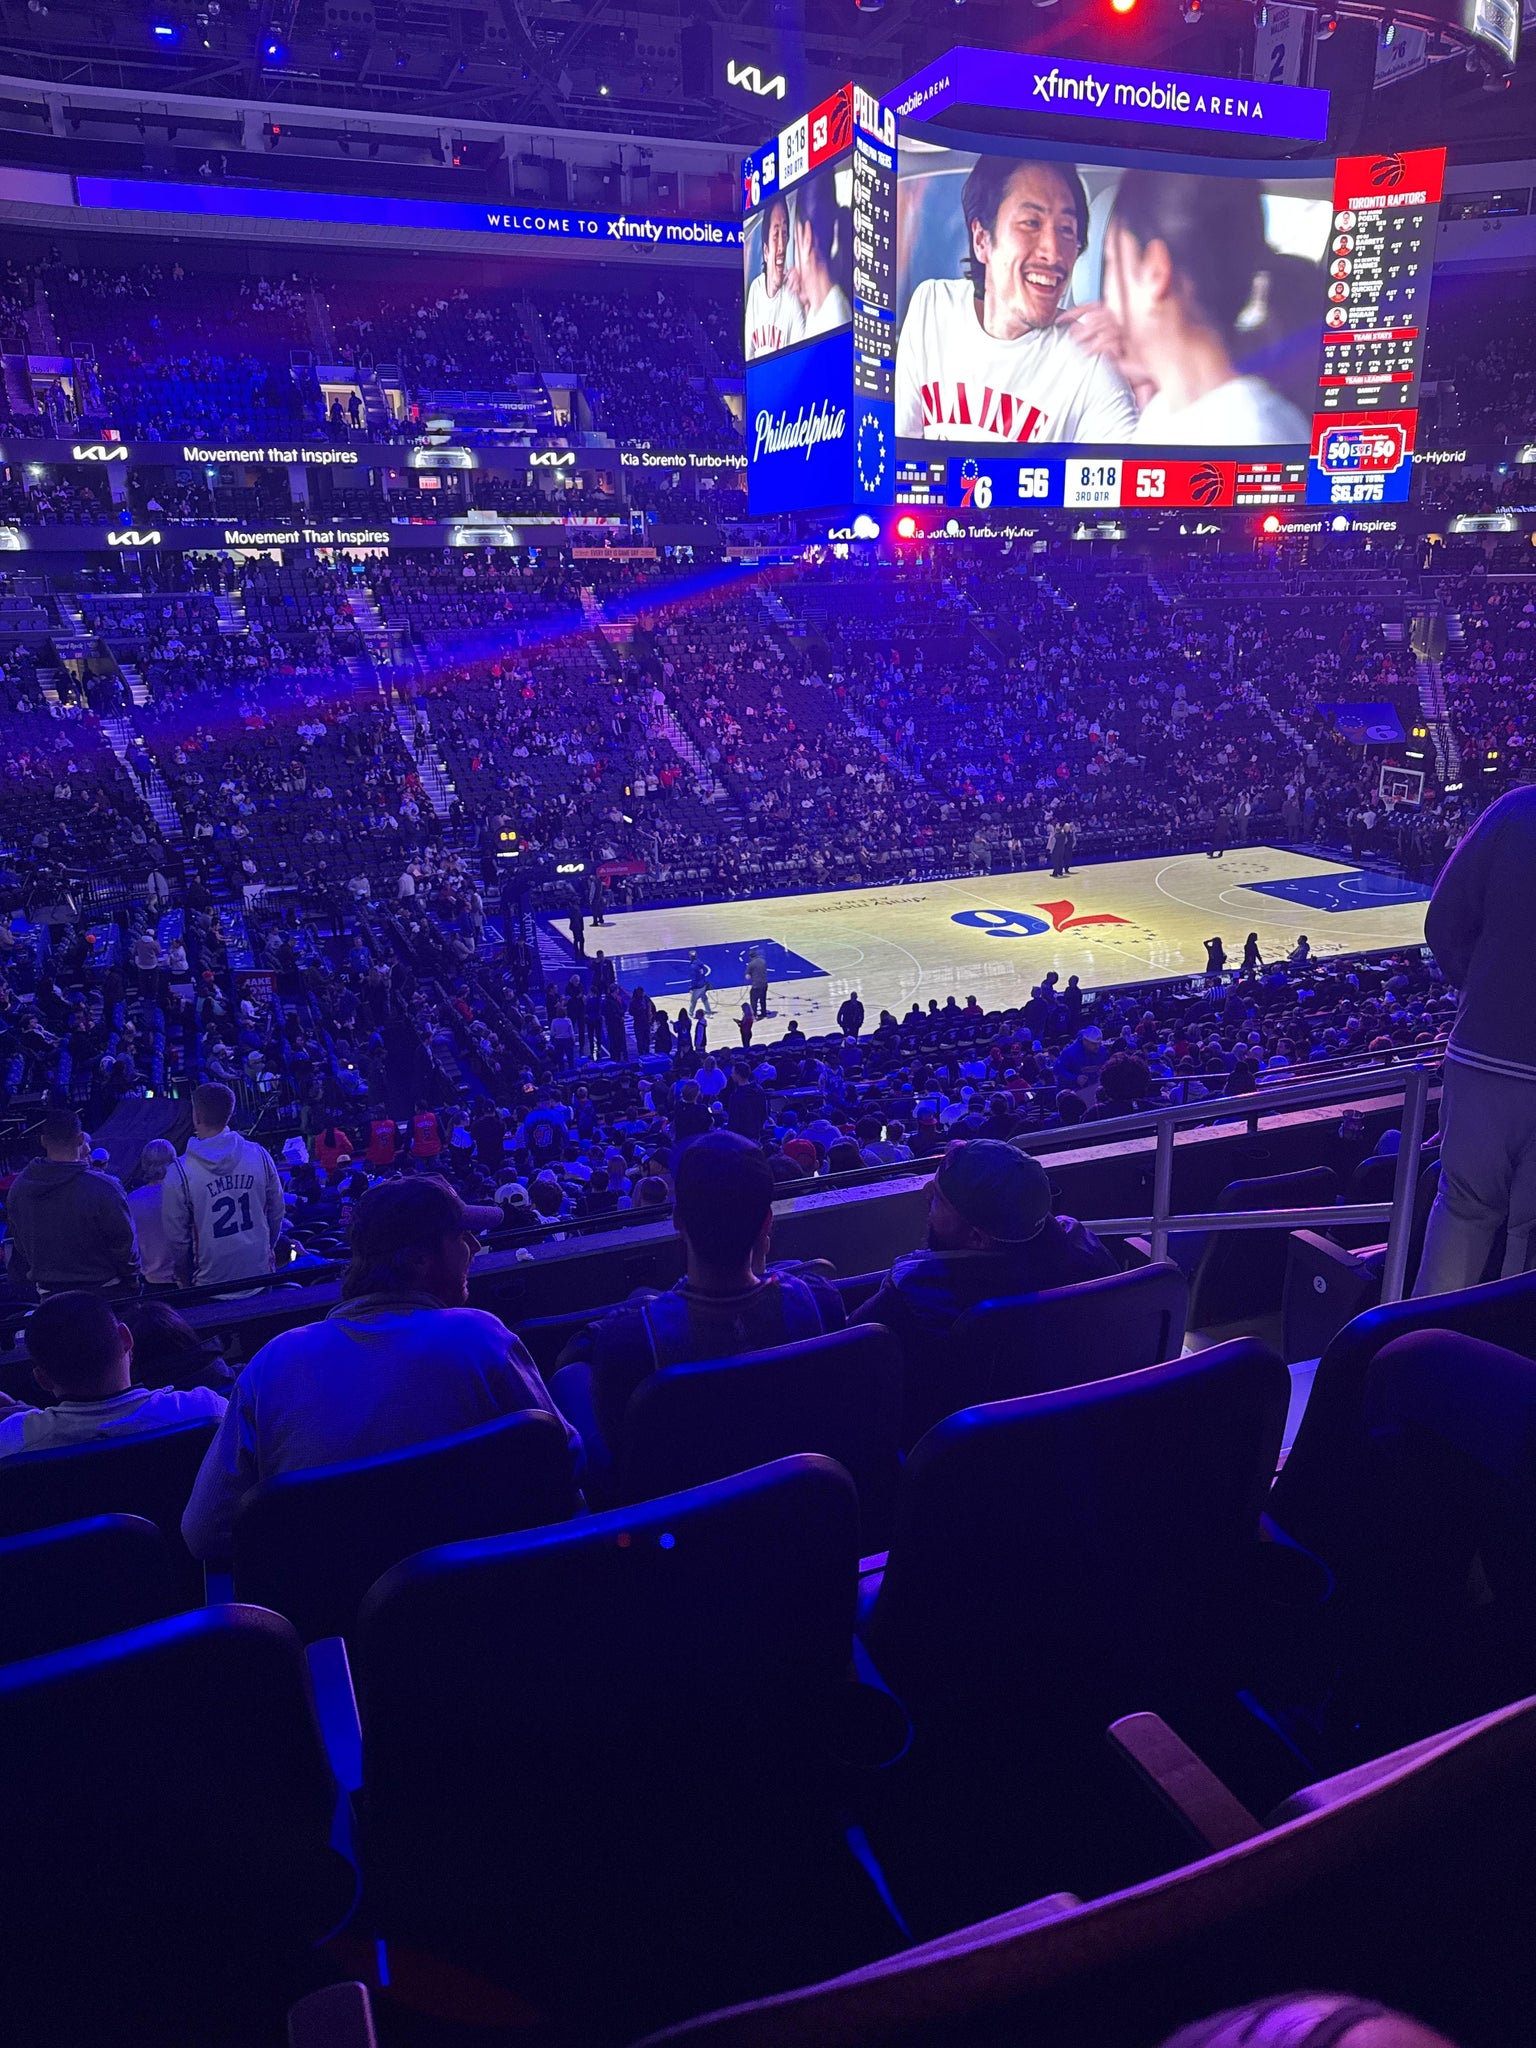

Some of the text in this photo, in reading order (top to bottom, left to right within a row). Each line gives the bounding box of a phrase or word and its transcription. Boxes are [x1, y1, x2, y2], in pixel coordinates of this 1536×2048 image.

[923, 76, 950, 102] ARENA
[1032, 69, 1263, 119] xfinity mobile ARENA
[853, 86, 896, 149] PHILA
[786, 126, 806, 158] 8:18
[813, 115, 828, 152] 53
[762, 152, 775, 185] 56
[744, 170, 760, 210] 76
[1348, 191, 1426, 209] TORONTO RAPTORS
[487, 214, 570, 232] WELCOME
[578, 220, 598, 233] TO
[607, 217, 663, 241] xfinity
[666, 223, 723, 243] mobile
[1372, 332, 1392, 340] STATS
[1345, 374, 1392, 384] TEAM LEADERS
[1326, 388, 1340, 396] AST
[753, 398, 845, 462] Philadelphia
[183, 447, 358, 465] Movement that inspires
[620, 453, 639, 466] Kia
[642, 454, 686, 467] Sorento
[1328, 442, 1350, 460] 50
[1372, 440, 1396, 458] 50
[1081, 467, 1116, 486] 8:18
[1136, 468, 1166, 498] 53
[1332, 476, 1364, 484] CURRENT
[960, 468, 1049, 509] 76 56
[1076, 492, 1110, 501] 3RD QTR
[1330, 484, 1384, 503] $6,875
[1352, 520, 1396, 533] Inspires
[224, 530, 390, 546] Movement That Inspires
[523, 912, 536, 948] xfinity
[206, 1174, 254, 1198] EMBIID
[211, 1192, 254, 1238] 21
[1316, 1280, 1322, 1289] 2
